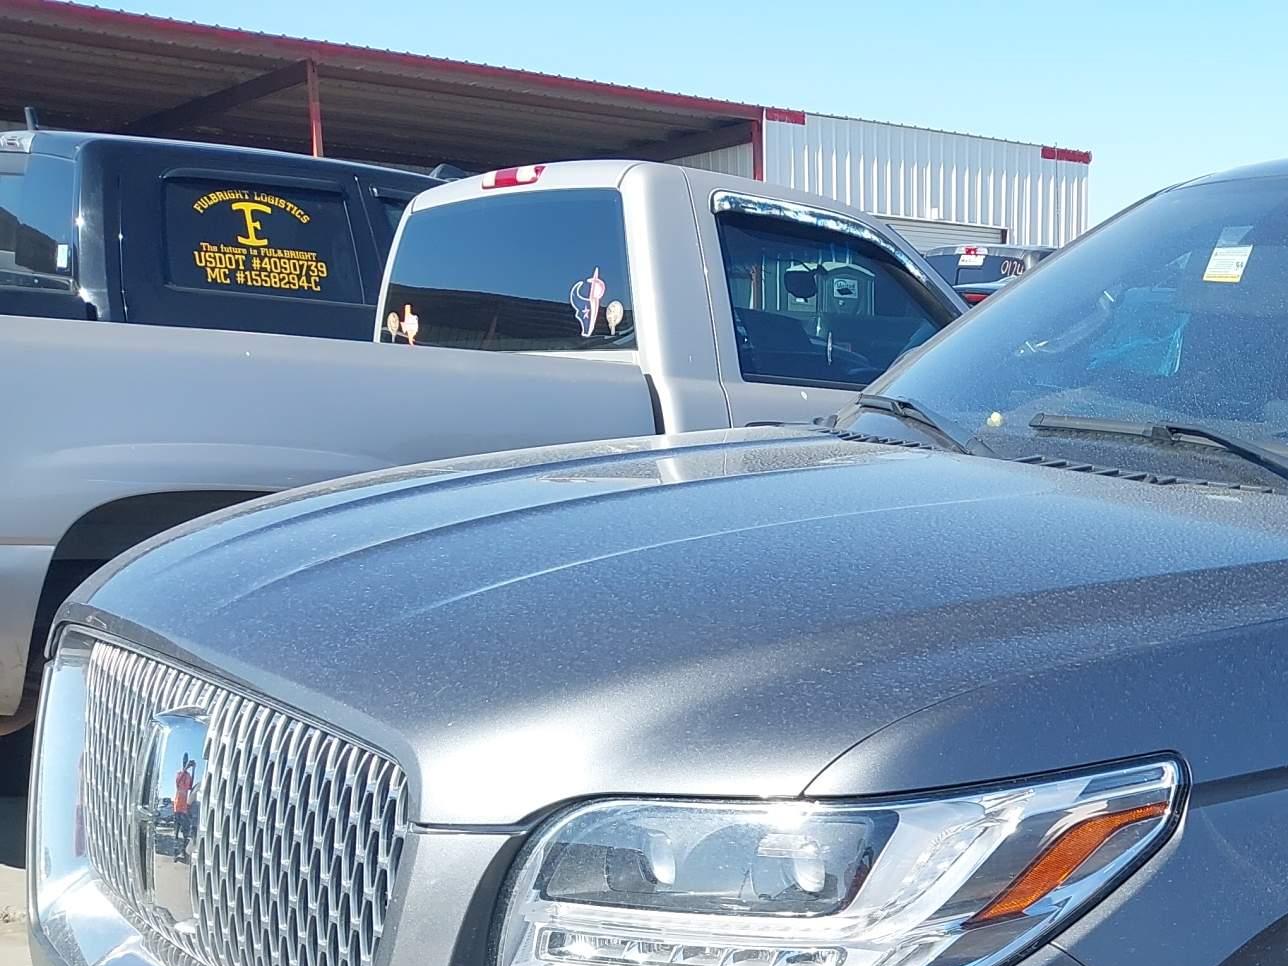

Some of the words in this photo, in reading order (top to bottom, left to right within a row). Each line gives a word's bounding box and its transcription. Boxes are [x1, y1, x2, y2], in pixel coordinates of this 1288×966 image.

[193, 190, 249, 214] FULBRIGHT
[254, 191, 311, 224] LOGISTICS
[200, 242, 218, 252] The
[220, 244, 247, 255] future
[249, 248, 258, 256] is
[193, 251, 246, 269] USDOT
[252, 257, 327, 278] #4090739
[206, 267, 230, 284] MC
[236, 271, 321, 292] #1558294-C
